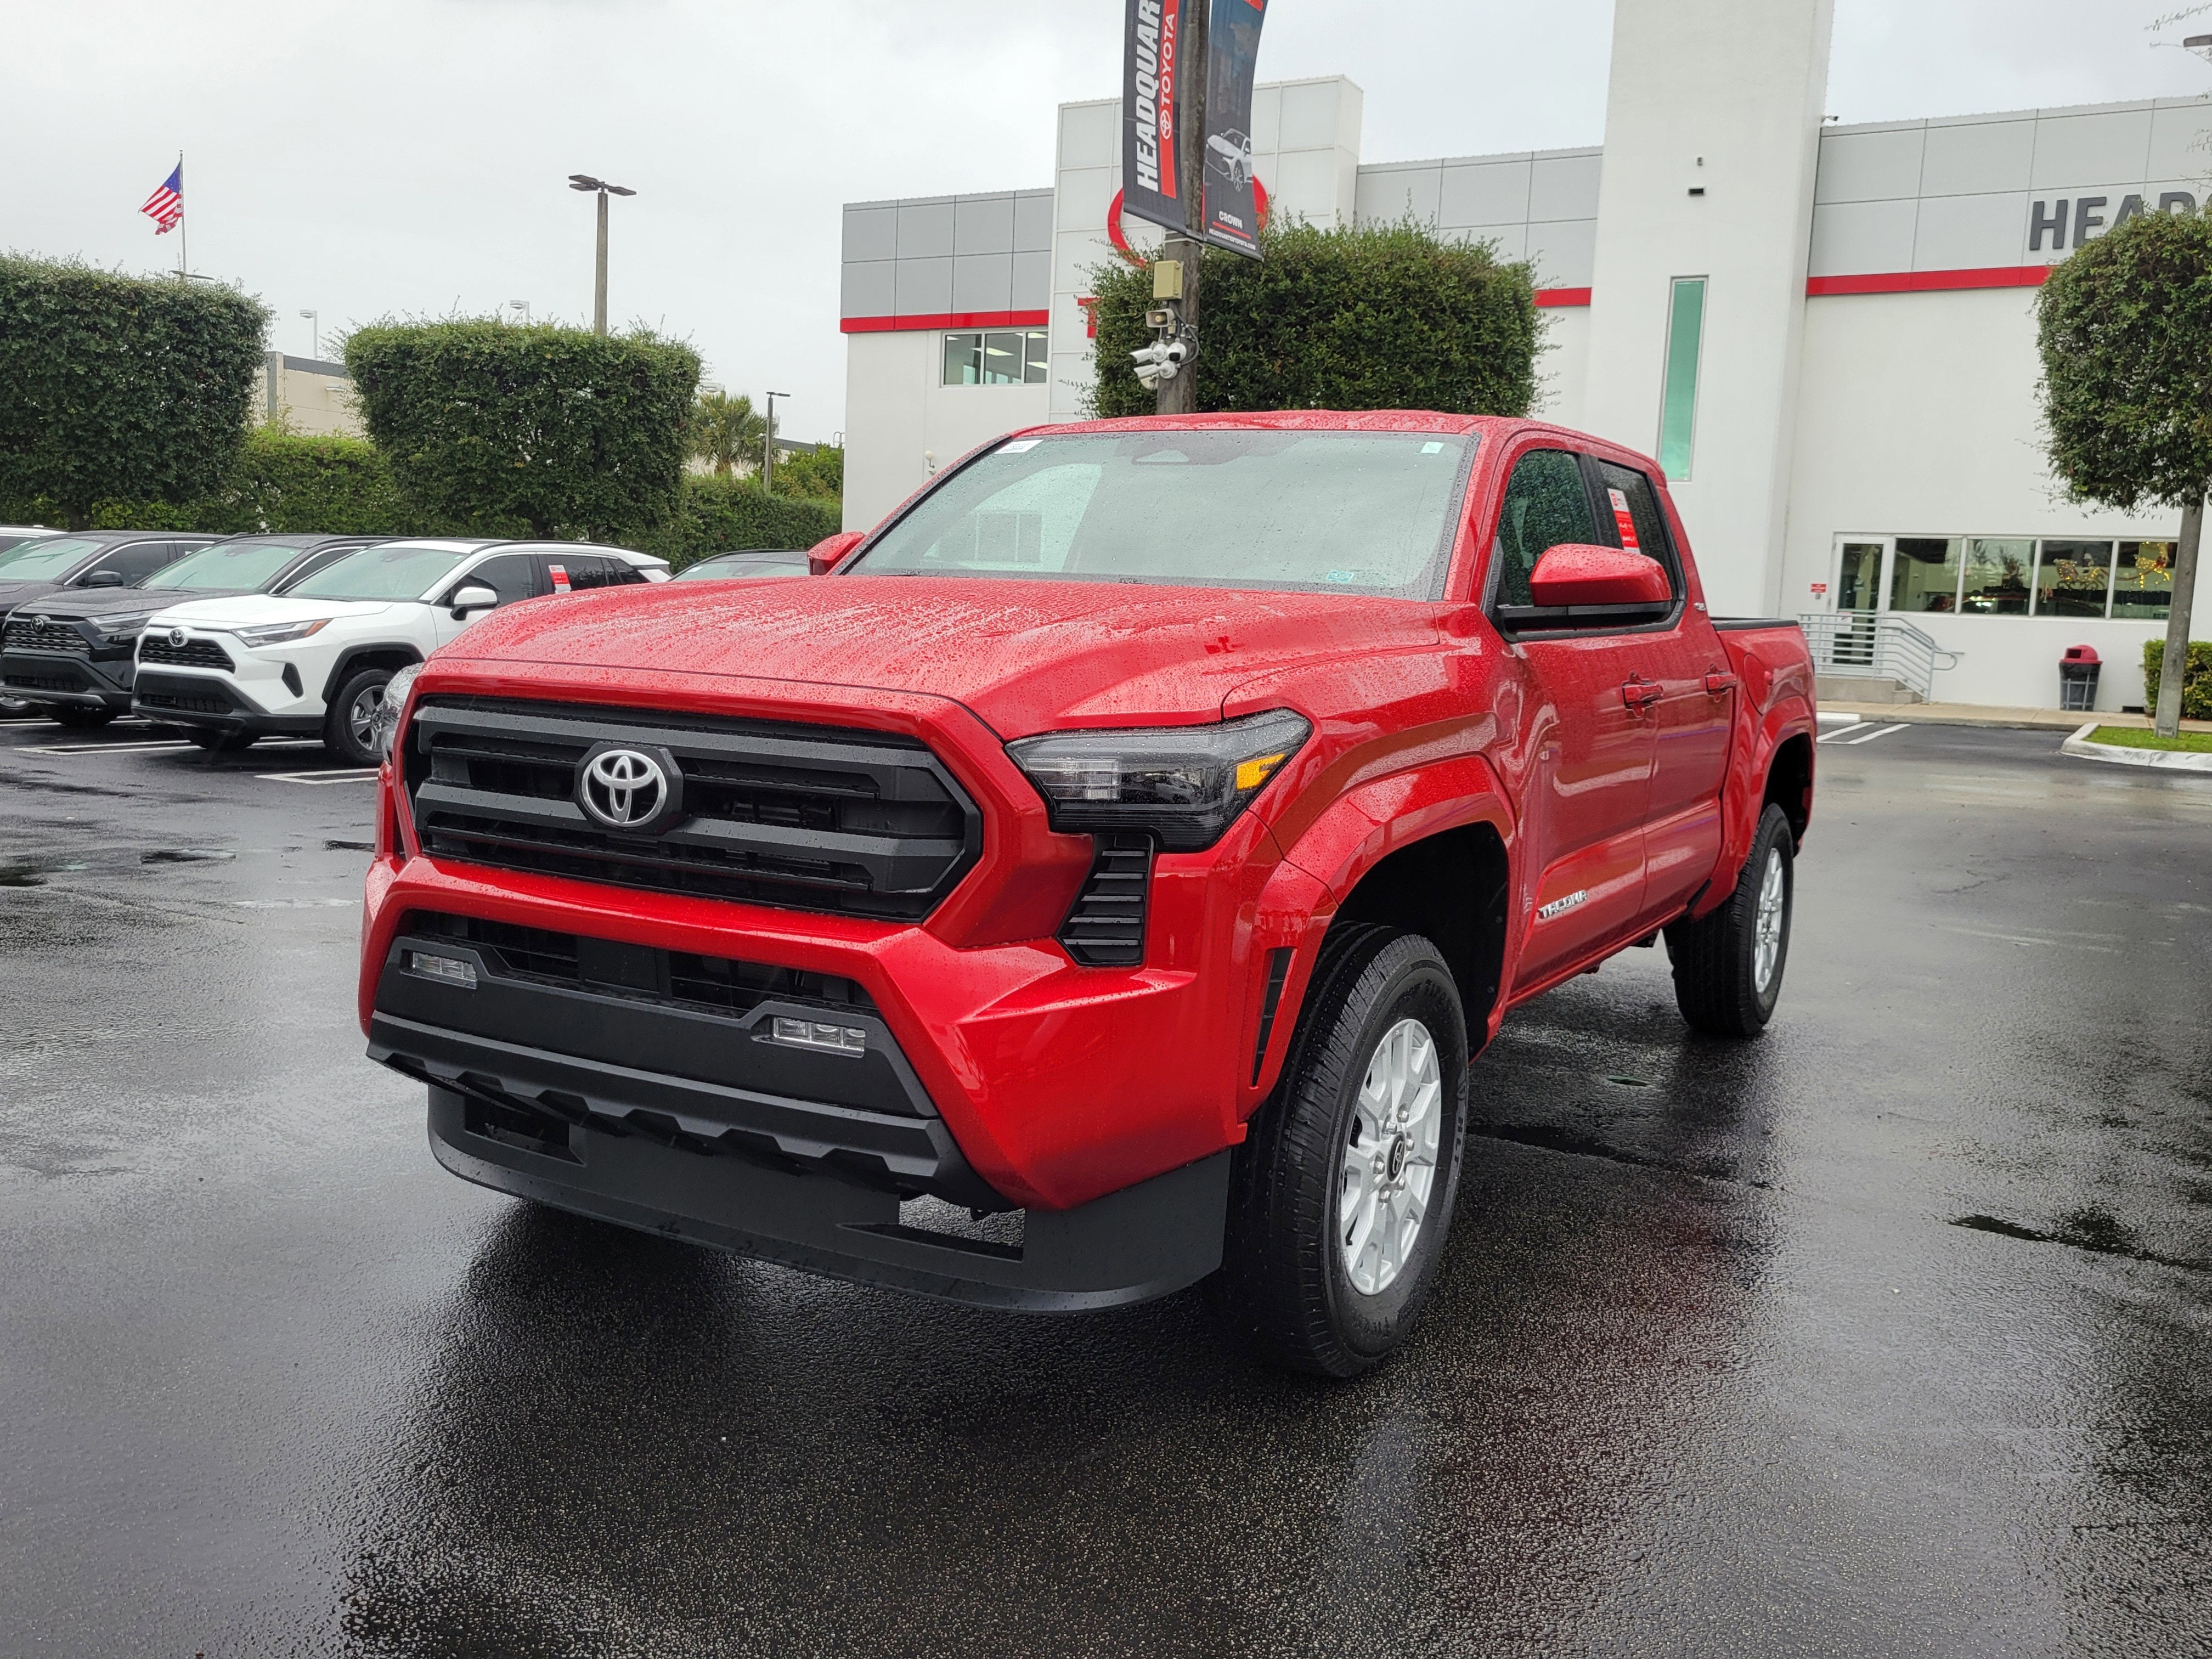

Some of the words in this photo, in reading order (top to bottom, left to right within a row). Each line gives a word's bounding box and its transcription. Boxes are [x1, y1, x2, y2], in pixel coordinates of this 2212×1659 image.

[1161, 14, 1175, 106] TOYOTA
[1136, 0, 1160, 192] HEADQUAR
[1218, 211, 1243, 229] CROWN
[2029, 191, 2212, 250] HEAD
[1538, 889, 1587, 918] TACOMA
